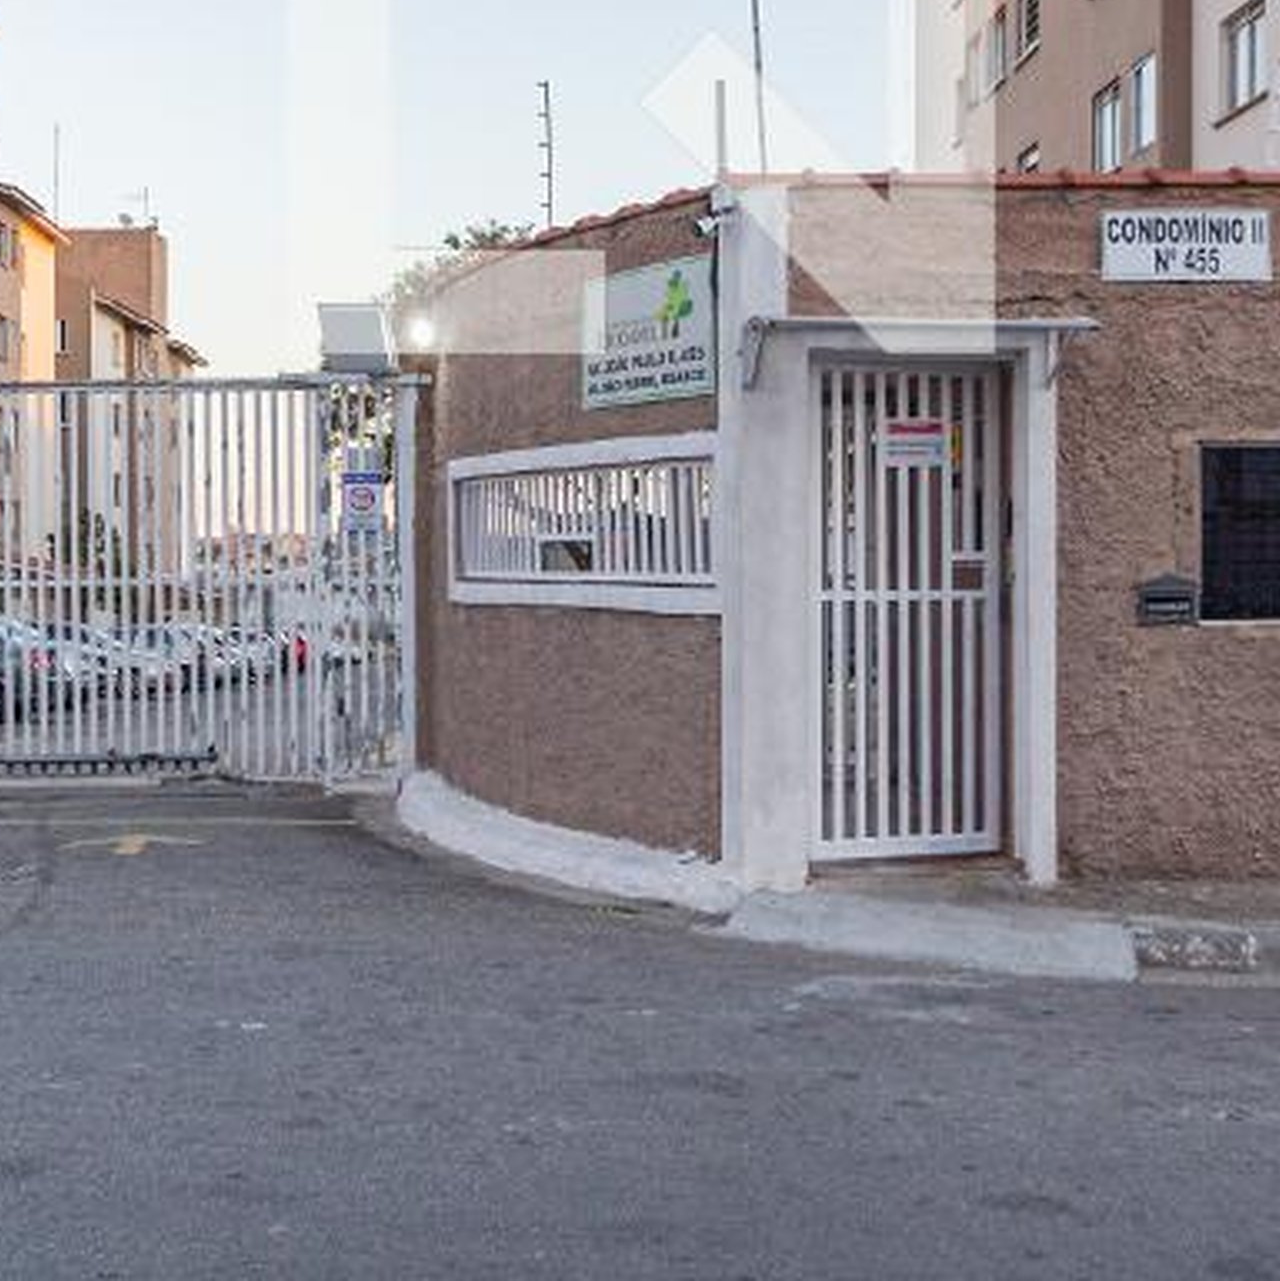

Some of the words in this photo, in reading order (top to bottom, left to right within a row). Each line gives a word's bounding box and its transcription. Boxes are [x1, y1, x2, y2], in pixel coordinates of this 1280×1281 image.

[1107, 213, 1243, 244] CONDOMÍNIO
[1251, 218, 1264, 244] II
[1184, 247, 1221, 274] 455
